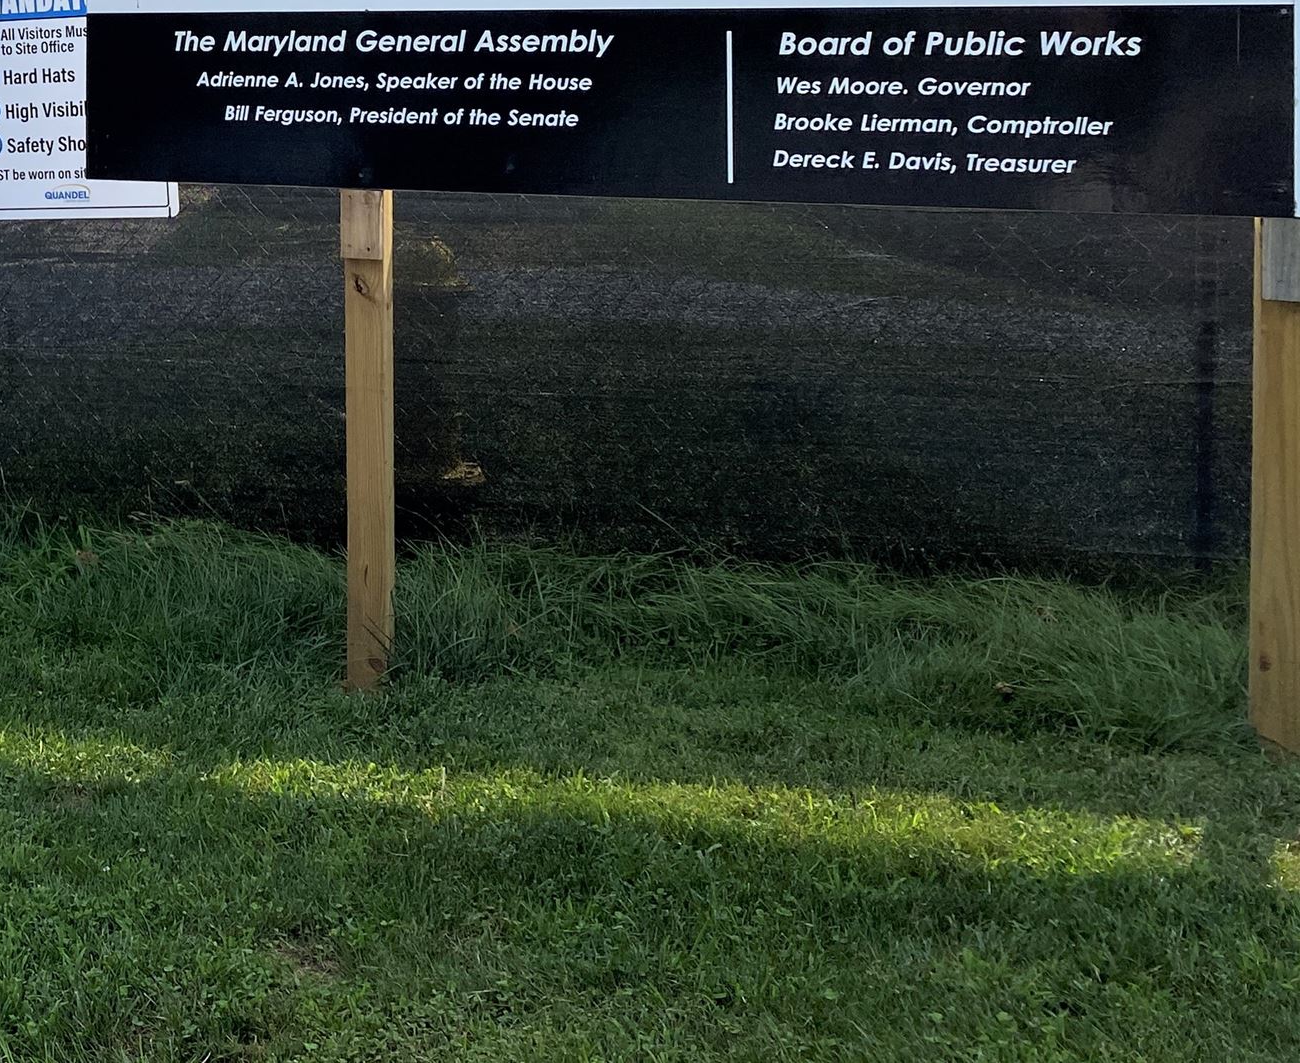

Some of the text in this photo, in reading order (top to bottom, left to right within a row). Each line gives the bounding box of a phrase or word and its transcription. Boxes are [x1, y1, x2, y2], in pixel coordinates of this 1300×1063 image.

[0, 28, 15, 41] All
[17, 26, 62, 40] Visitors
[174, 29, 615, 58] The Maryland General Assembly
[778, 30, 1142, 57] Board of Public Works
[1, 40, 75, 56] to Site Office
[3, 68, 76, 85] Hard Hats
[196, 71, 593, 93] Adrienne A. Jones, Speaker of the House
[777, 76, 1032, 97] Wes Moore. Governor
[5, 102, 39, 123] High
[224, 104, 579, 127] Bill Ferguson, President of the Senate
[774, 113, 1114, 139] Brooke Lierman, Comptroller
[7, 137, 54, 156] Safety
[772, 149, 1077, 174] Dereck E. Davis, Treasurer
[12, 169, 26, 181] be
[28, 170, 55, 180] worn
[58, 170, 72, 179] on
[44, 191, 90, 200] QUANDEL
